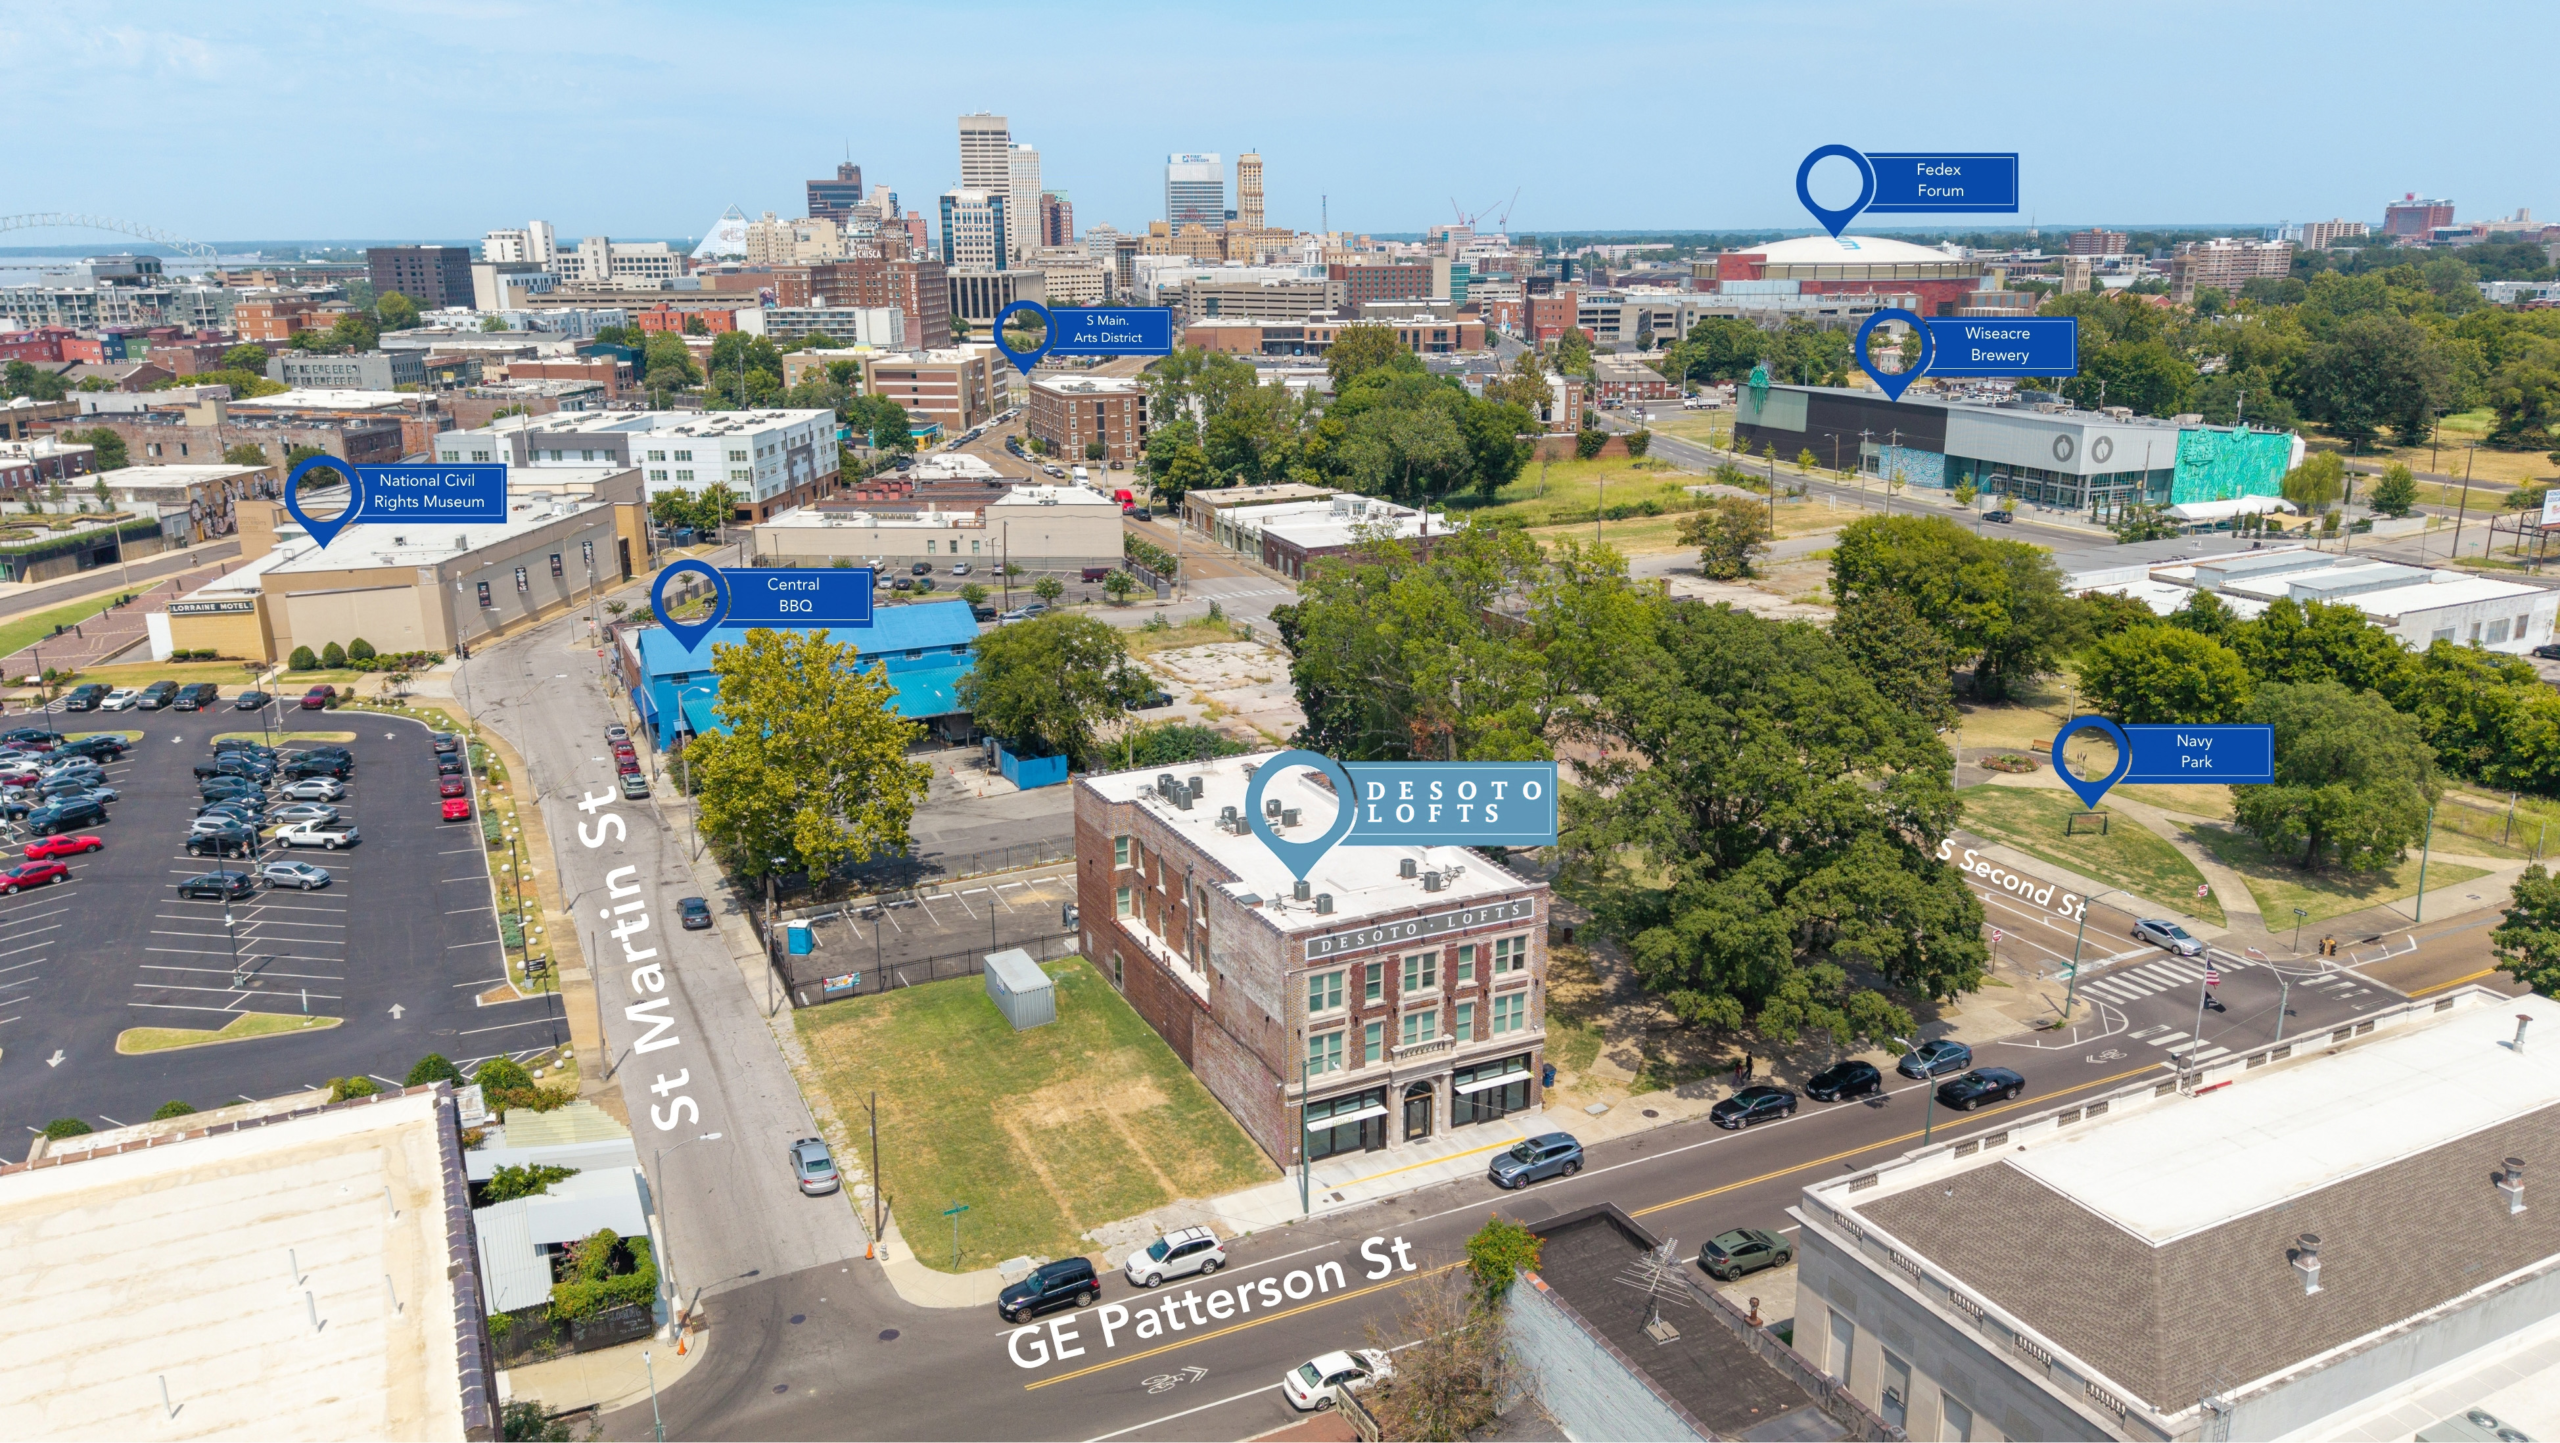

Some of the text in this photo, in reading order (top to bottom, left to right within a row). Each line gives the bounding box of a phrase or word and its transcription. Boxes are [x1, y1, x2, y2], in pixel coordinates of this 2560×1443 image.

[857, 249, 882, 259] CHISCA
[172, 602, 249, 612] LORRAINE MOTEL
[1321, 904, 1520, 953] DESOTO LOFTS
